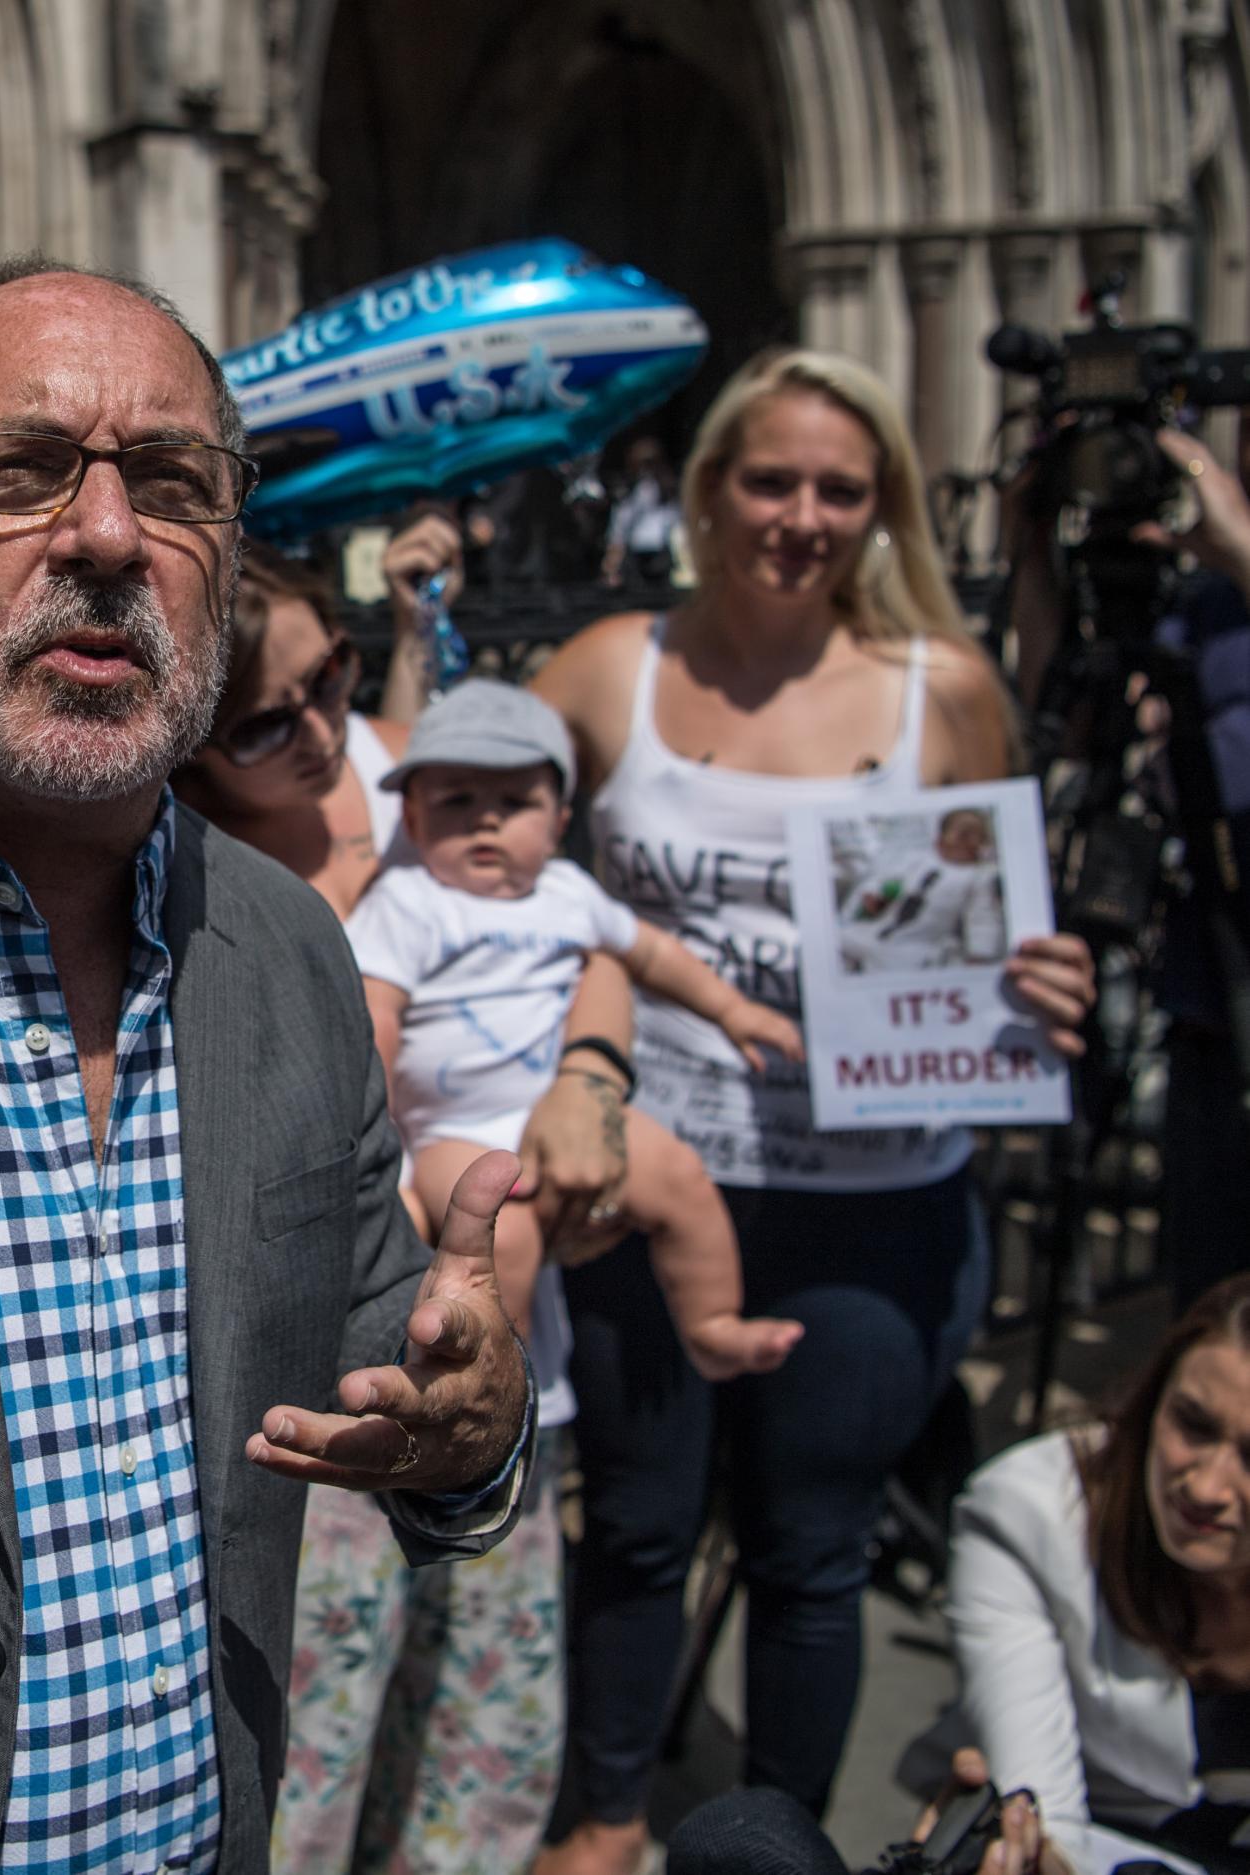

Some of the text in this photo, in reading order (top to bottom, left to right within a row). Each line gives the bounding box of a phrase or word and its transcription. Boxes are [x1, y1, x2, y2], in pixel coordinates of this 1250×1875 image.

[605, 833, 741, 901] SAVE
[888, 987, 972, 1029] IT'S
[835, 1045, 1038, 1089] MURDER
